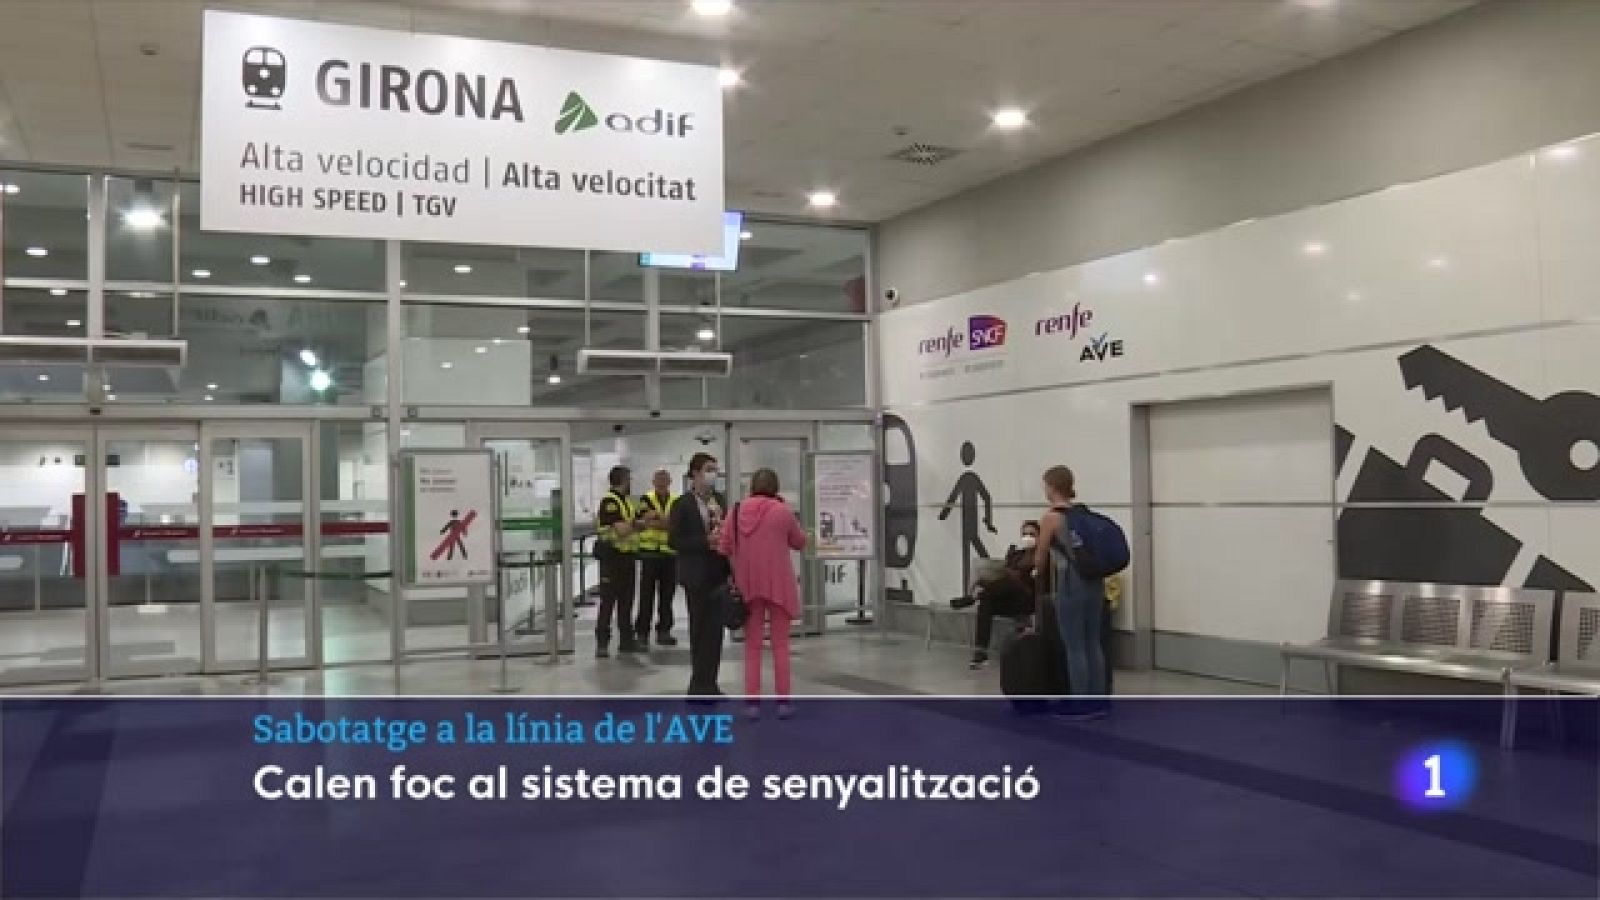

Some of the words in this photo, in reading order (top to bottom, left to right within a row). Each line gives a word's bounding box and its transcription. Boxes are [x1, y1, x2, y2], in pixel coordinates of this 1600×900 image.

[315, 60, 524, 123] GIRONA
[240, 142, 303, 172] Alta
[317, 150, 470, 183] velocidad
[502, 162, 560, 191] Alta
[572, 169, 697, 201] velocitat
[240, 184, 304, 207] HIGH
[313, 187, 387, 214] SPEED
[412, 194, 457, 217] TGV
[1034, 302, 1093, 340] renfe
[1079, 339, 1124, 362] AVE
